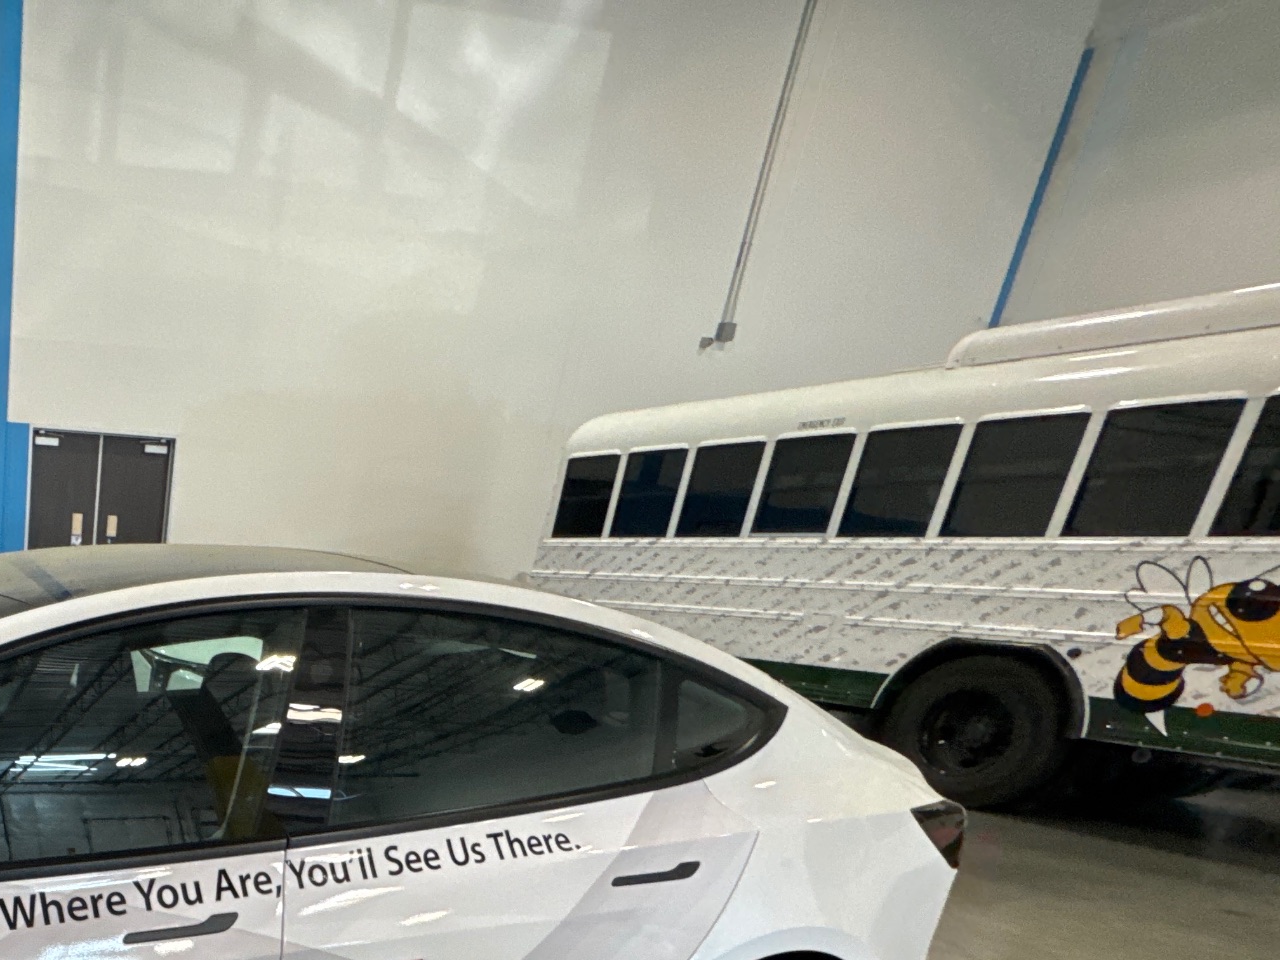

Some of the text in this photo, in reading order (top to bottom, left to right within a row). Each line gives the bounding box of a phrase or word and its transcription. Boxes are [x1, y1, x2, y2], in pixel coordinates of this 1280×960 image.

[133, 878, 204, 912] You
[215, 868, 283, 902] Are,
[384, 845, 442, 876] See
[446, 837, 487, 866] Us
[486, 829, 582, 861] There.
